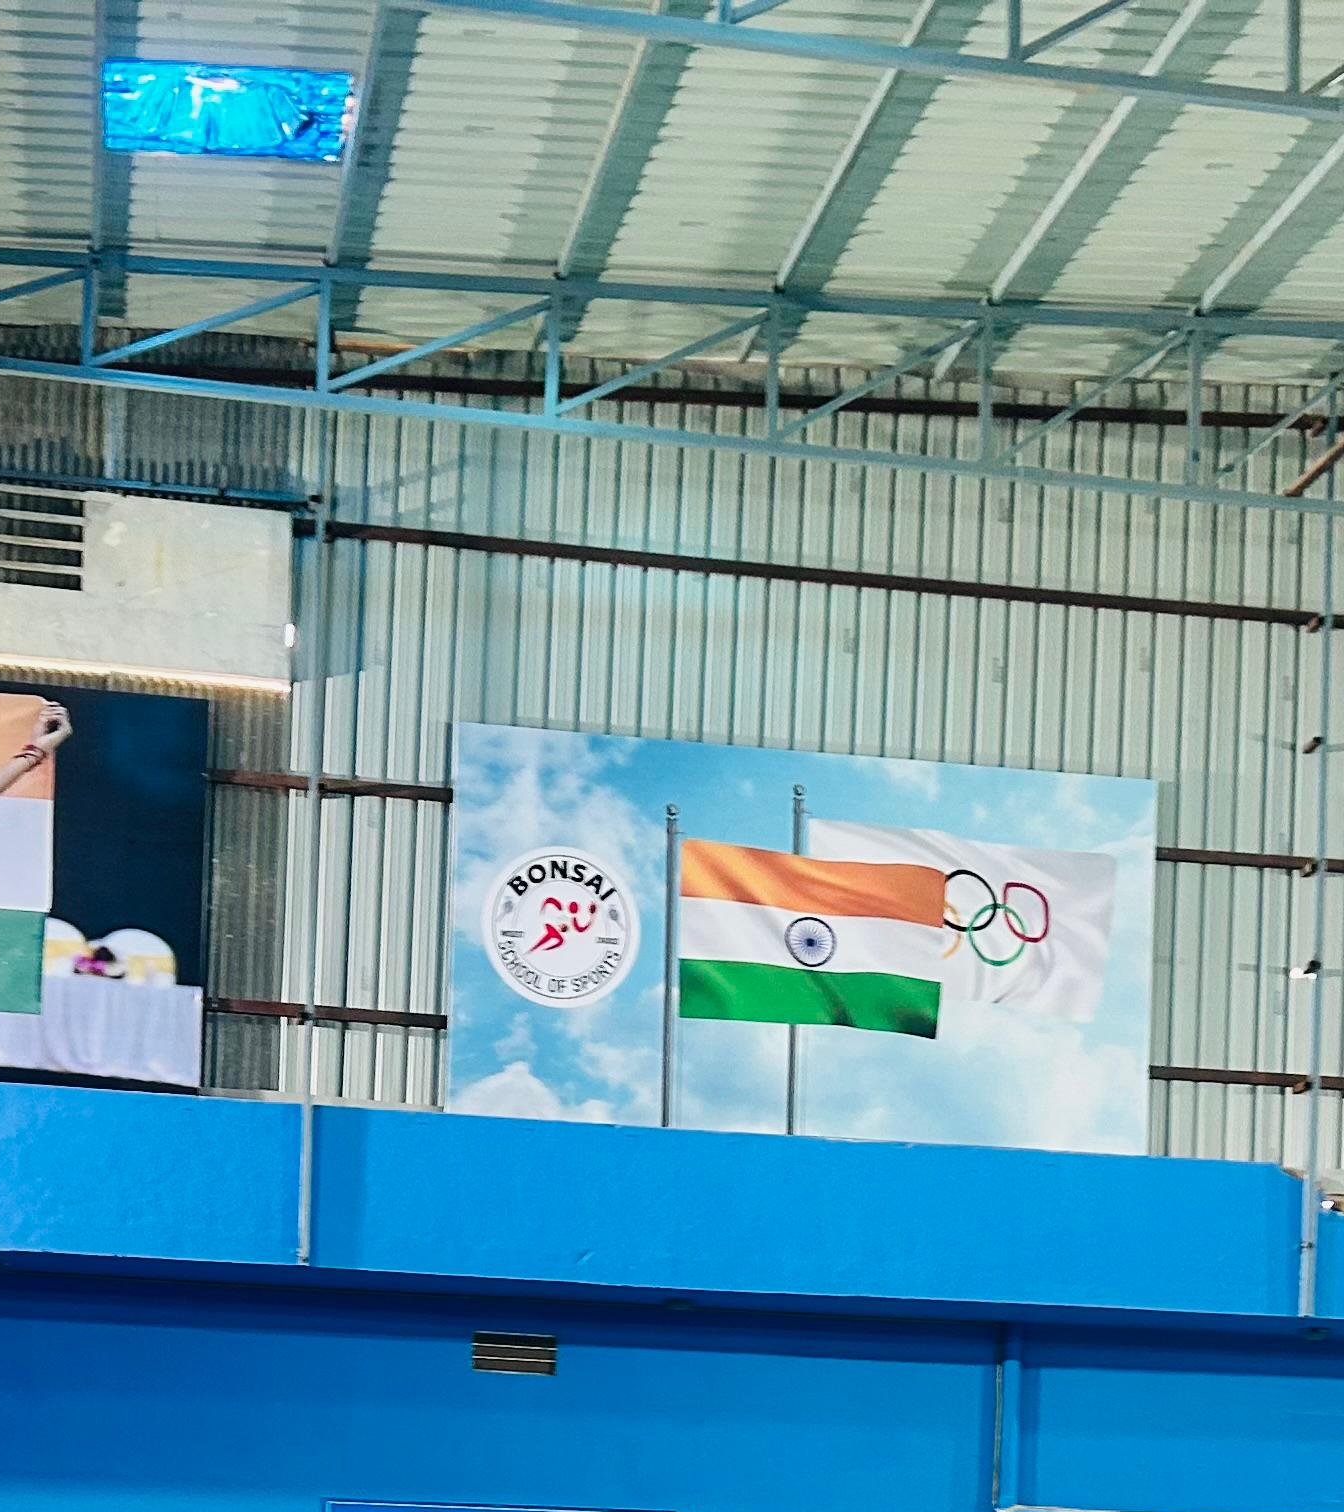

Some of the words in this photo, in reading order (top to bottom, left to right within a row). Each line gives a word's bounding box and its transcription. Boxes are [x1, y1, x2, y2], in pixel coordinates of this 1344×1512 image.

[507, 860, 617, 901] BONSAI
[498, 940, 542, 989] SCHOOL
[547, 978, 567, 993] OF
[571, 949, 621, 992] SPORTS
